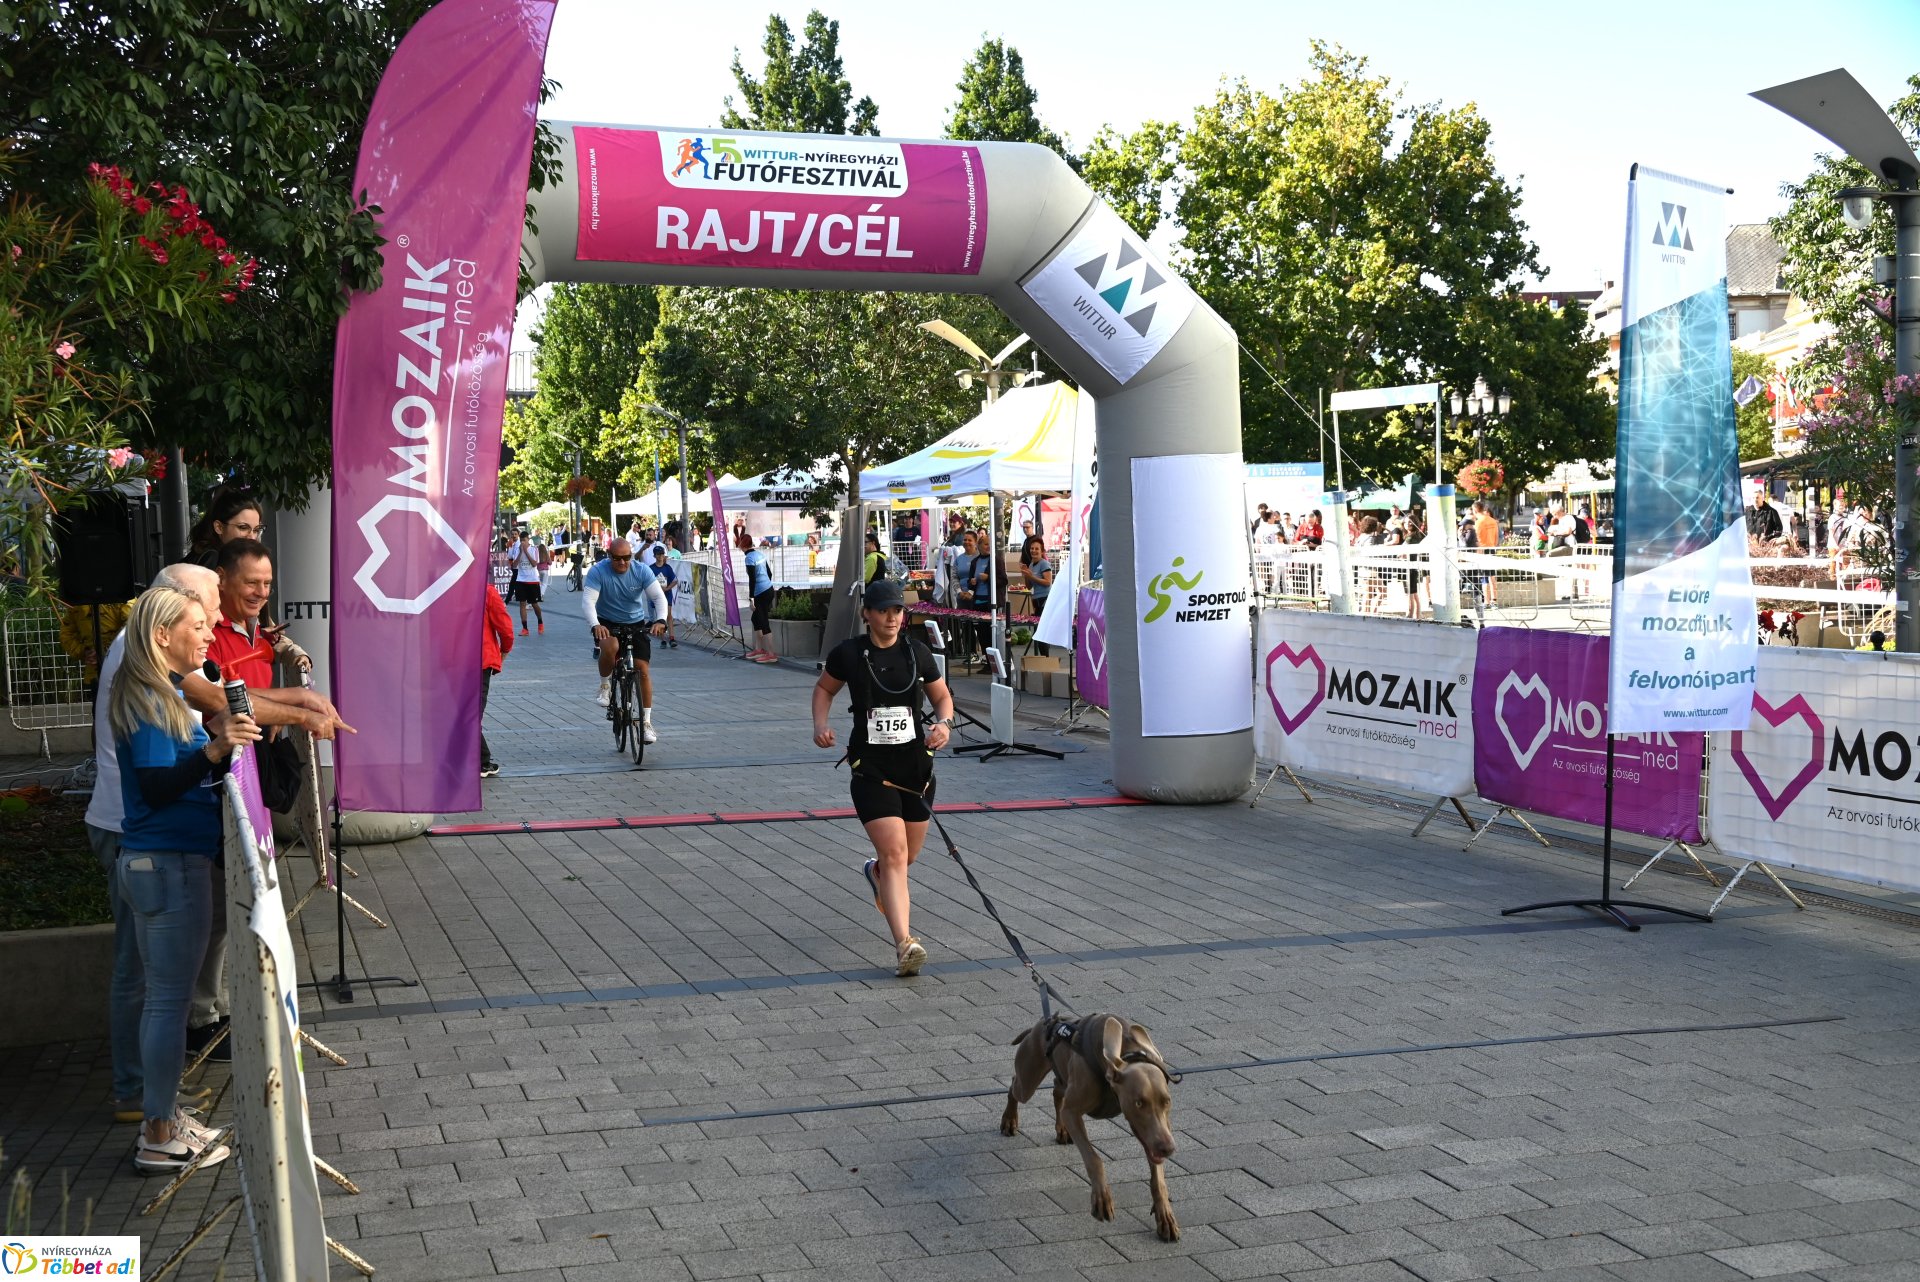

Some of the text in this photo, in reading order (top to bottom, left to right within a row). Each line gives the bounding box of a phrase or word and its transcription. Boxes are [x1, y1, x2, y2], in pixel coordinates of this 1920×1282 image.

[744, 149, 899, 166] WITTUR-NYÍREGYHÁZI
[713, 161, 902, 189] FUTÓFESZTIVÁL
[588, 148, 601, 231] www.mozaikmed.hu
[962, 150, 977, 269] www.nyiregyhazifutofesztival.hu
[656, 204, 914, 259] RAJT/CÉL
[453, 258, 477, 325] med
[1073, 295, 1117, 340] WITTUR
[461, 332, 489, 497] Az orvosi futóközösség
[1188, 587, 1247, 607] SPORTOLÓ
[1175, 608, 1231, 623] NEMZET
[1684, 646, 1695, 661] a
[1628, 666, 1756, 690] felvonóipart
[1663, 707, 1729, 718] www.wittur.com
[875, 719, 908, 732] 5156
[1419, 719, 1458, 739] med
[1326, 723, 1417, 750] Az orvosi futóközösség
[1552, 757, 1563, 769] Az
[1642, 750, 1679, 771] med
[1827, 806, 1843, 820] Az
[1847, 811, 1883, 826] orvosi
